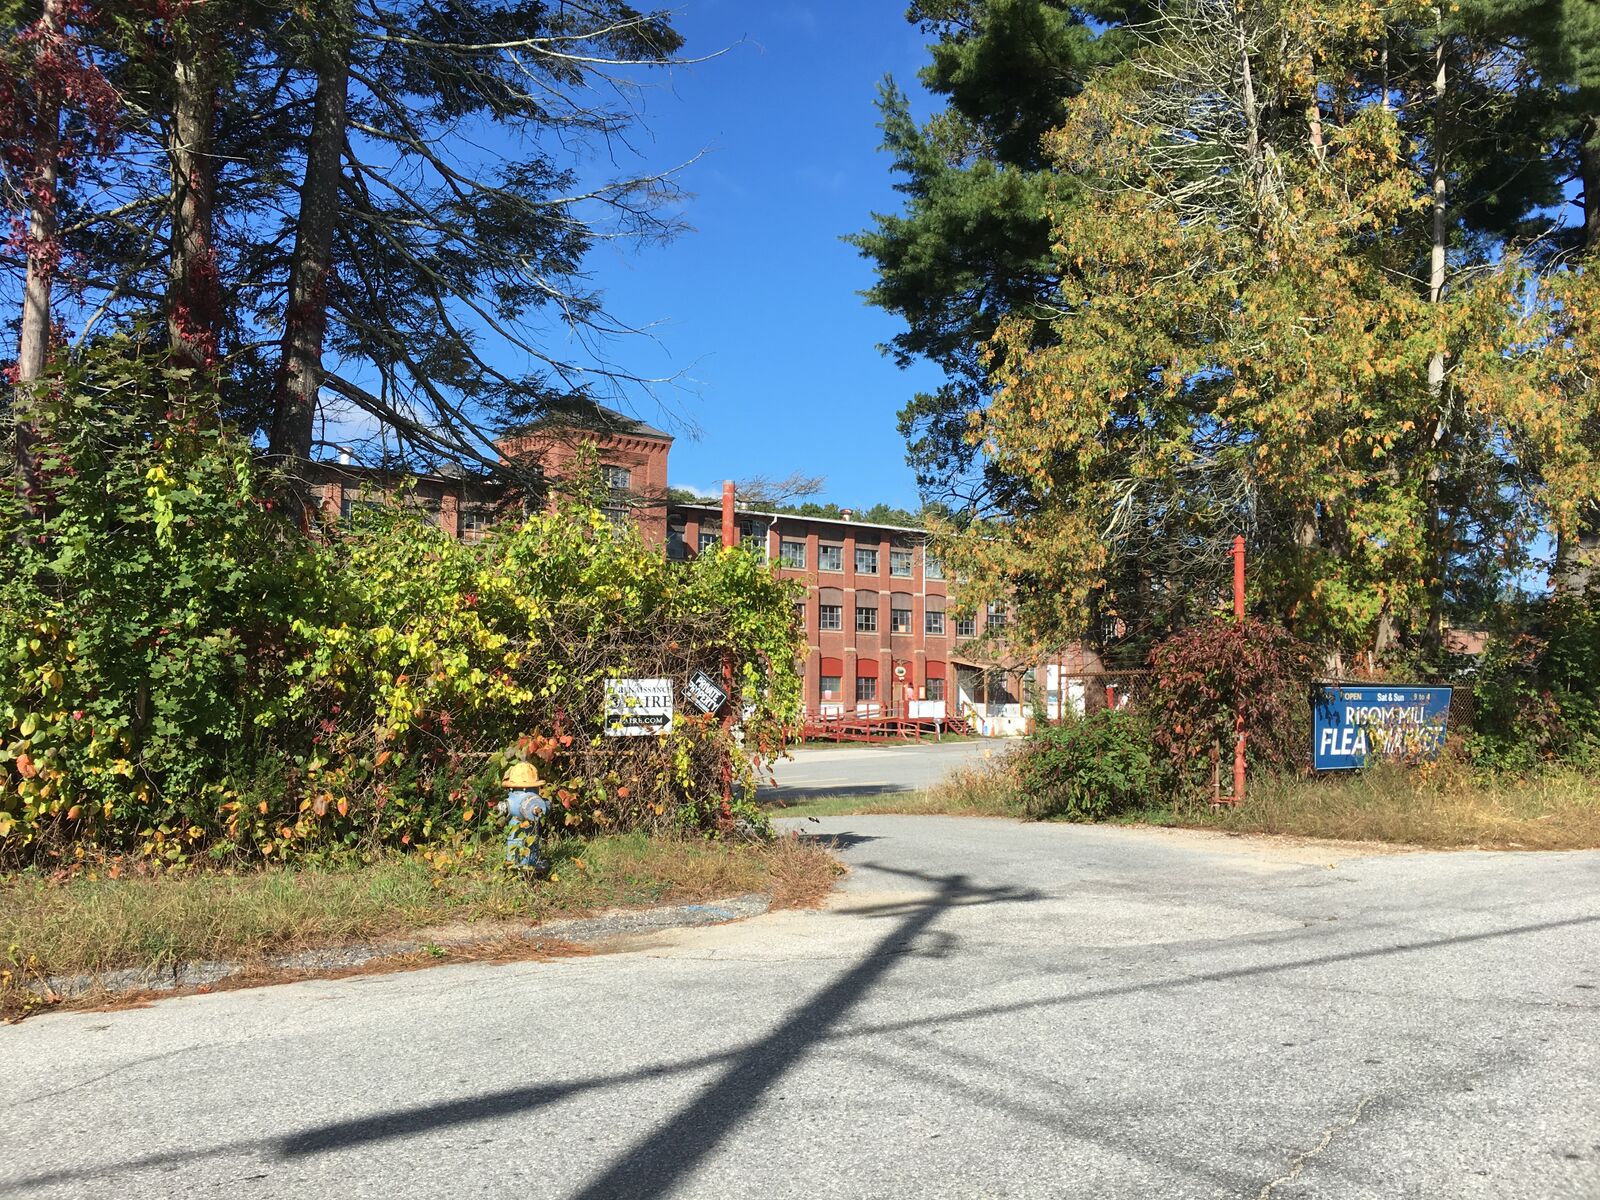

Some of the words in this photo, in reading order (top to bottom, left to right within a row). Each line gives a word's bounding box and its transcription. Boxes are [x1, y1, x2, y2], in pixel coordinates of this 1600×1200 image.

[689, 680, 719, 711] PROPERTY
[696, 676, 721, 702] PRIVATE
[625, 695, 671, 708] AIRE
[1344, 693, 1362, 701] OPEN
[1377, 693, 1388, 702] Sat
[1388, 693, 1393, 702] &
[1394, 693, 1405, 702] Sun
[609, 717, 664, 725] CAIRE.COM
[1320, 728, 1367, 755] FLEA
